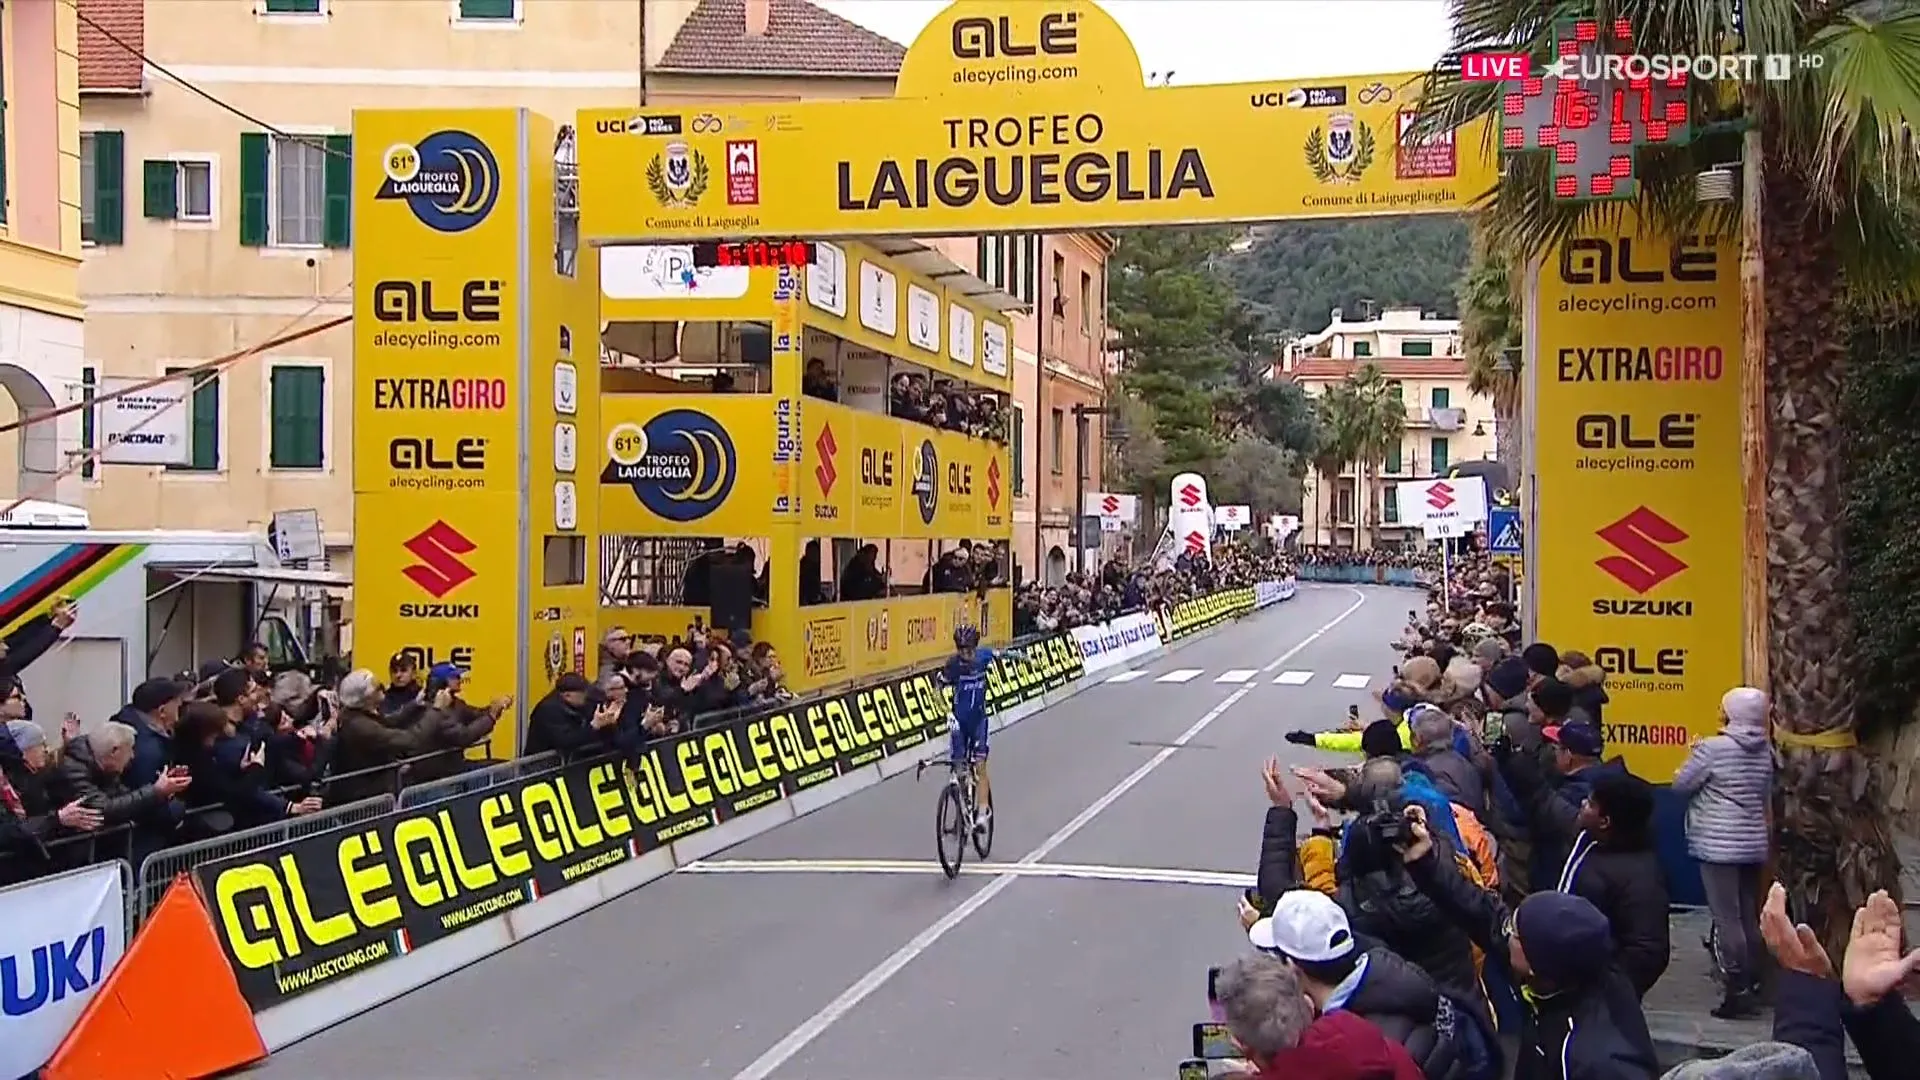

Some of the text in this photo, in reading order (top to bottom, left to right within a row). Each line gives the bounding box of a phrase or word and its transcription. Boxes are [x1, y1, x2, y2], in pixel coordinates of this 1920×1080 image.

[953, 66, 1078, 85] alecycling.com
[1251, 93, 1283, 107] UCI
[597, 120, 626, 133] UCI
[943, 113, 1104, 149] TROFEO
[418, 172, 459, 183] TROFEO
[837, 148, 1215, 211] LAIGUEGLIA
[393, 182, 461, 194] LAIGUEGLIA
[1302, 193, 1353, 208] Comune
[1356, 191, 1368, 205] di
[645, 211, 760, 230] Comune di Laigueglia
[1559, 293, 1717, 314] alecycling.com
[374, 331, 500, 350] alecycling.com
[773, 334, 791, 352] la
[1558, 346, 1722, 382] EXTRAGIRO
[375, 378, 506, 410] EXTRAGIRO
[646, 455, 691, 467] TROFEO
[1576, 456, 1695, 473] alecycling.com
[618, 466, 692, 479] LAIGUEGLIA
[389, 477, 485, 490] alecycling.com
[814, 504, 838, 519] SUZUKI
[1437, 525, 1450, 534] 10
[400, 603, 479, 618] SUZUKI
[1593, 600, 1693, 616] SUZUKI
[1601, 680, 1684, 691] ecycling.com
[440, 888, 523, 930] WWW.ALECYCLING.COM
[278, 940, 389, 995] WWW.ALECYCLING.COM
